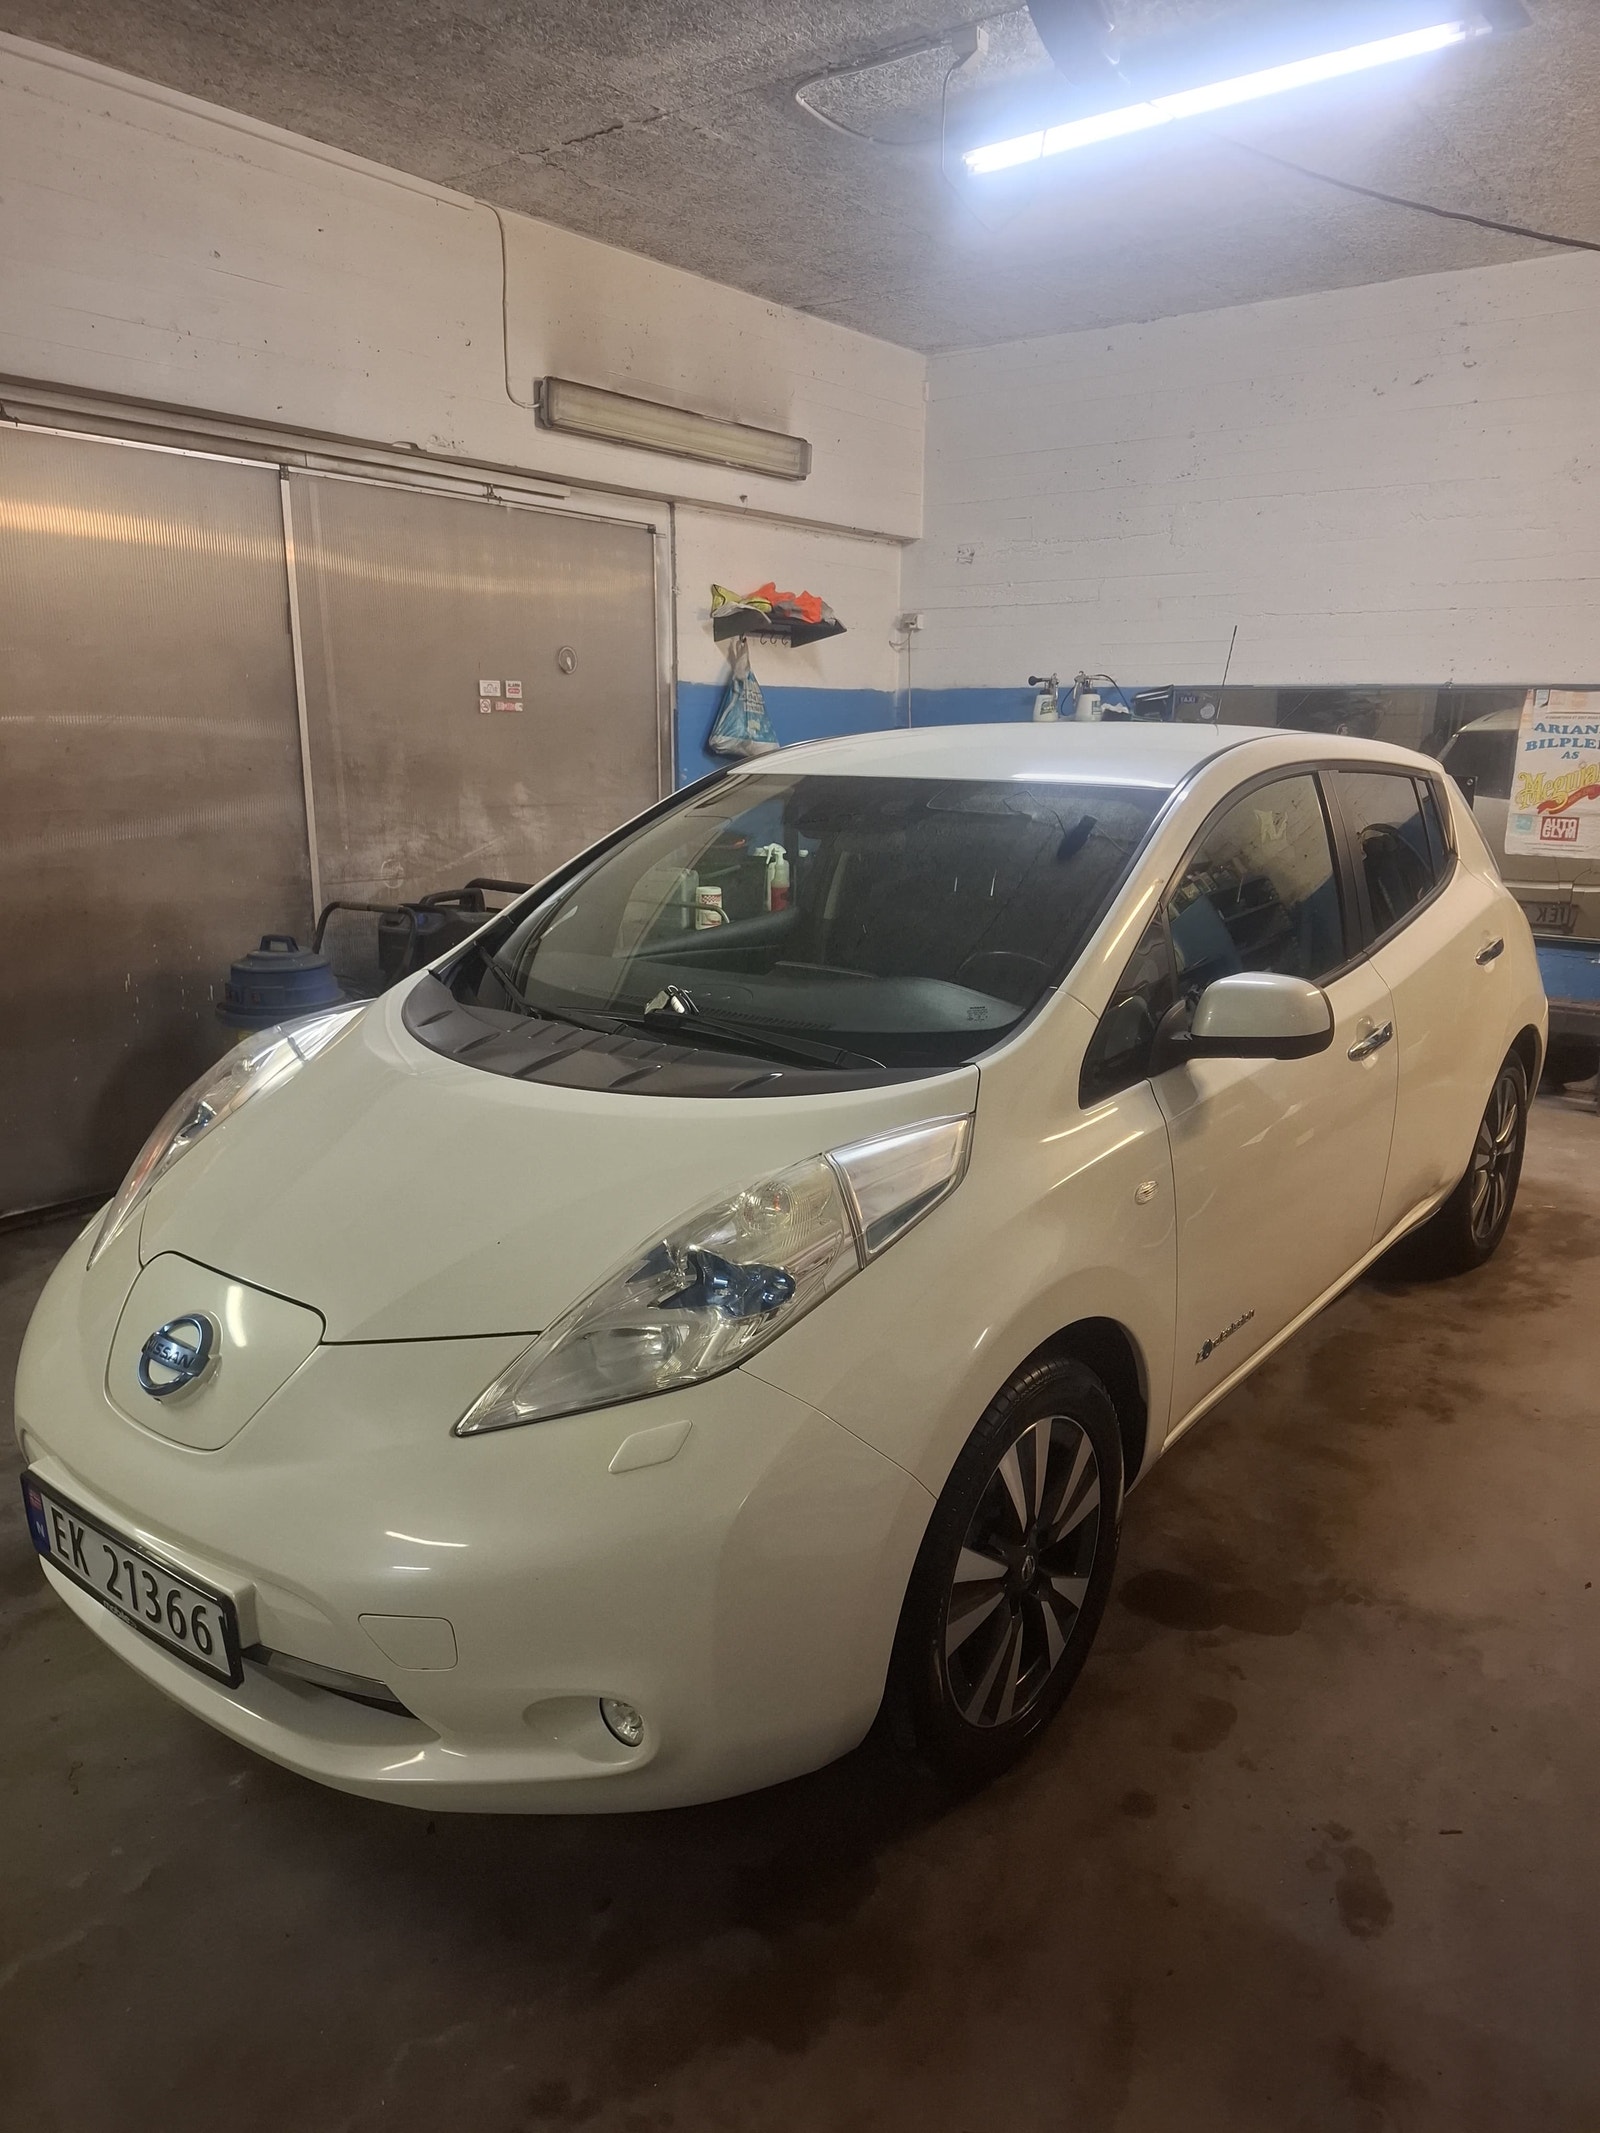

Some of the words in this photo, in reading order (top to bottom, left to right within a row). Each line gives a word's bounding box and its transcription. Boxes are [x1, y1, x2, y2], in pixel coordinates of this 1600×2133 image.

[1534, 722, 1600, 735] ARIAN
[1561, 751, 1580, 760] AS
[1516, 762, 1600, 812] Meguia
[1543, 818, 1577, 828] AUTO
[1542, 828, 1576, 838] GLYM
[145, 1338, 196, 1370] NISSAN
[36, 1521, 46, 1538] N
[51, 1506, 91, 1577] EK
[102, 1545, 213, 1655] 21366
